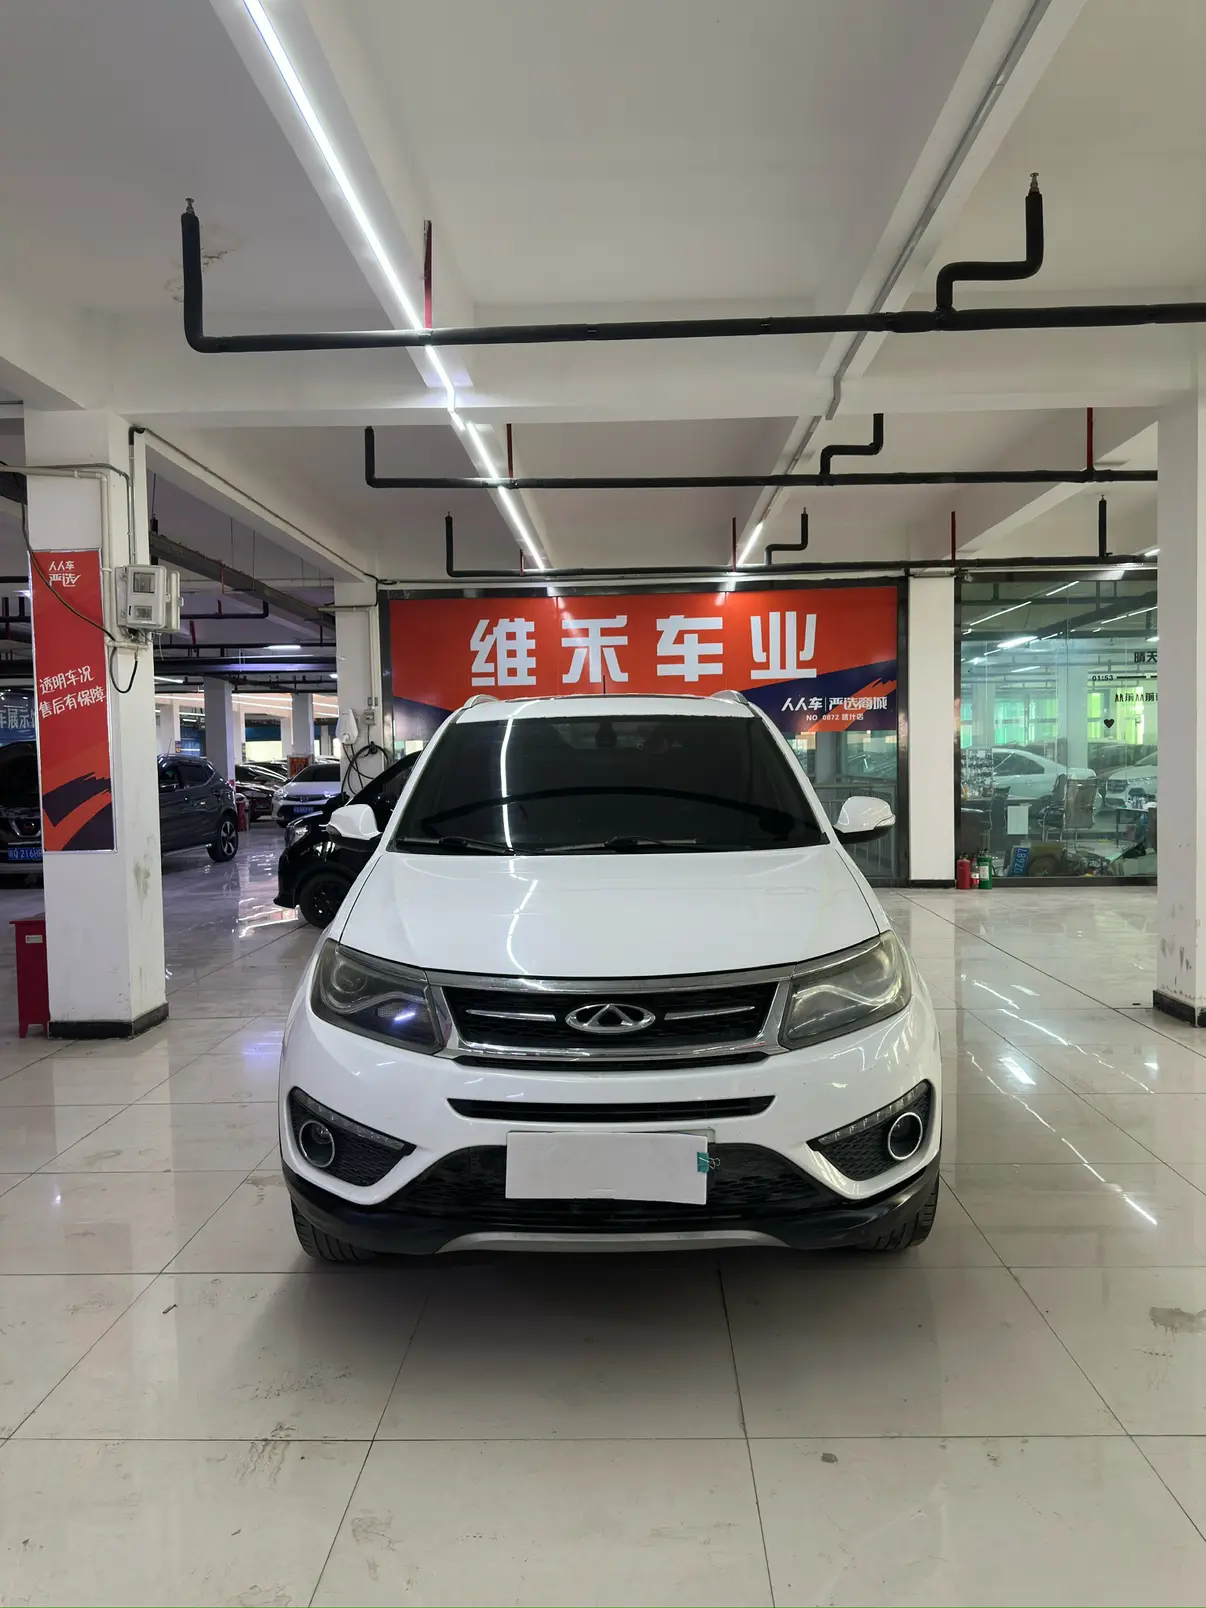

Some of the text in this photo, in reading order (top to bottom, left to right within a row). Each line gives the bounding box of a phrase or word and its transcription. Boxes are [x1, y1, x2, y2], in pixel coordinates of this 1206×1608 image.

[48, 560, 75, 571] 人人车
[49, 573, 80, 587] 严选
[470, 611, 818, 686] 维禾车业
[39, 665, 95, 694] 透明车况
[1091, 674, 1114, 682] 01:53
[38, 685, 107, 719] 售后有保障
[781, 696, 888, 712] 人人车 严选商城
